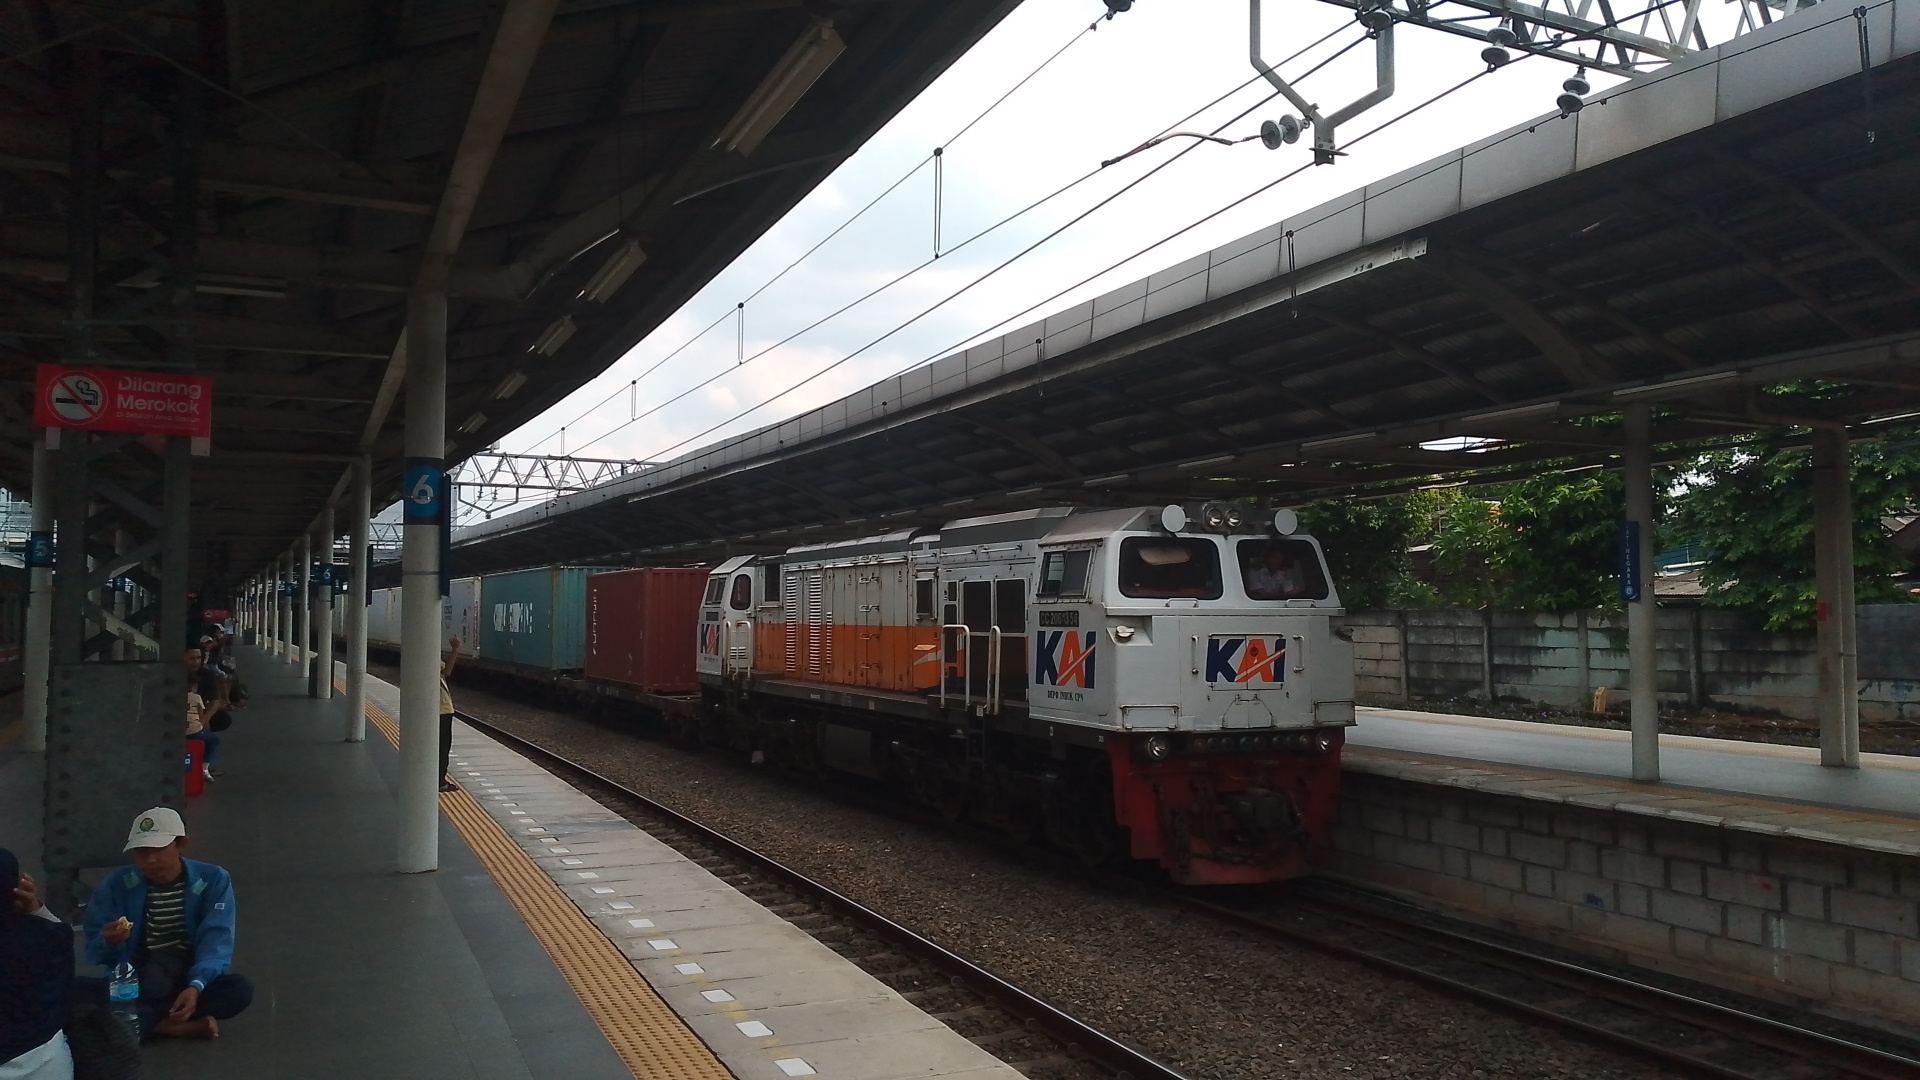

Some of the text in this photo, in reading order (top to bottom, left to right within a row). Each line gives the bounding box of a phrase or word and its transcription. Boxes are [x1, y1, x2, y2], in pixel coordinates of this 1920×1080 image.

[118, 376, 201, 399] Dilarang
[117, 394, 199, 414] Merokok
[412, 474, 434, 505] 6
[35, 540, 48, 557] 5
[323, 568, 331, 579] 6
[700, 624, 720, 656] KAI
[1035, 631, 1097, 689] KAI
[1205, 639, 1287, 682] KAI
